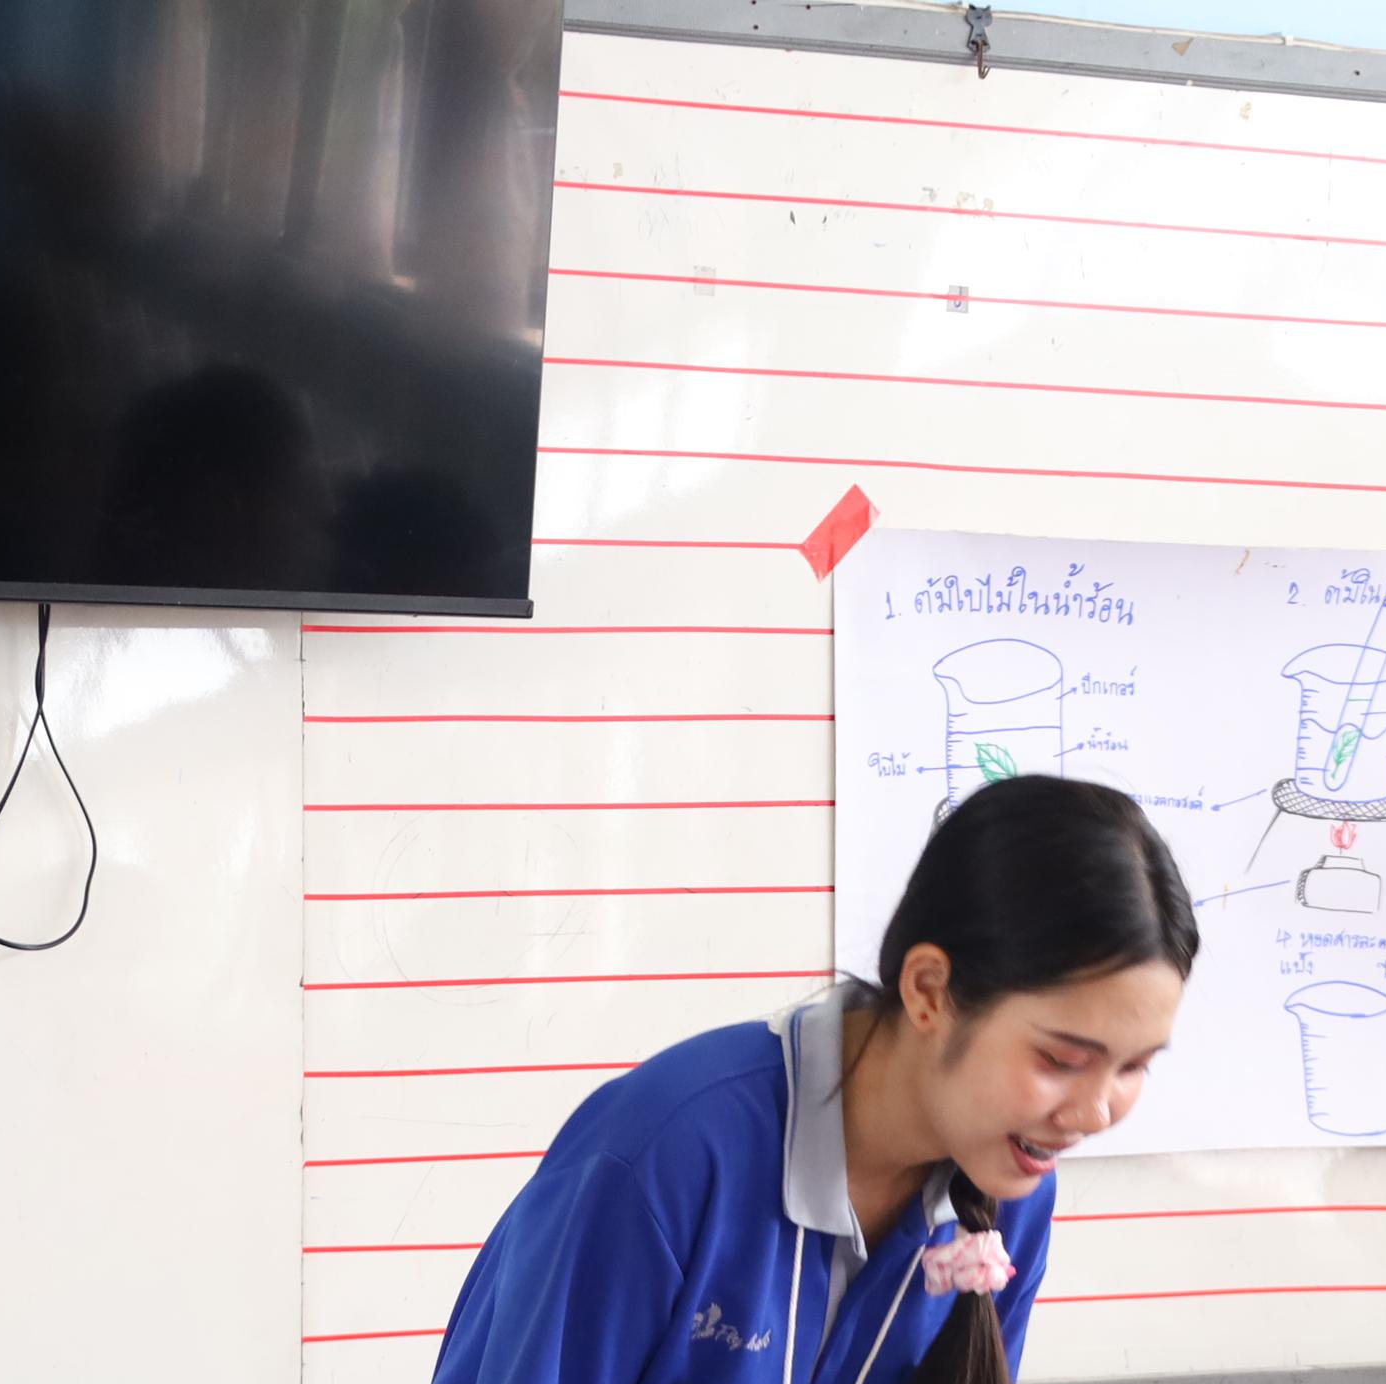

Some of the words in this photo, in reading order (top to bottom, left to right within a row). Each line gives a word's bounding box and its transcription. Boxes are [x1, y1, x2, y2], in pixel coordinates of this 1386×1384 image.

[914, 563, 1134, 625] ต้มใบไม้ในน้ำร้อน
[868, 752, 911, 777] ใบไม้
